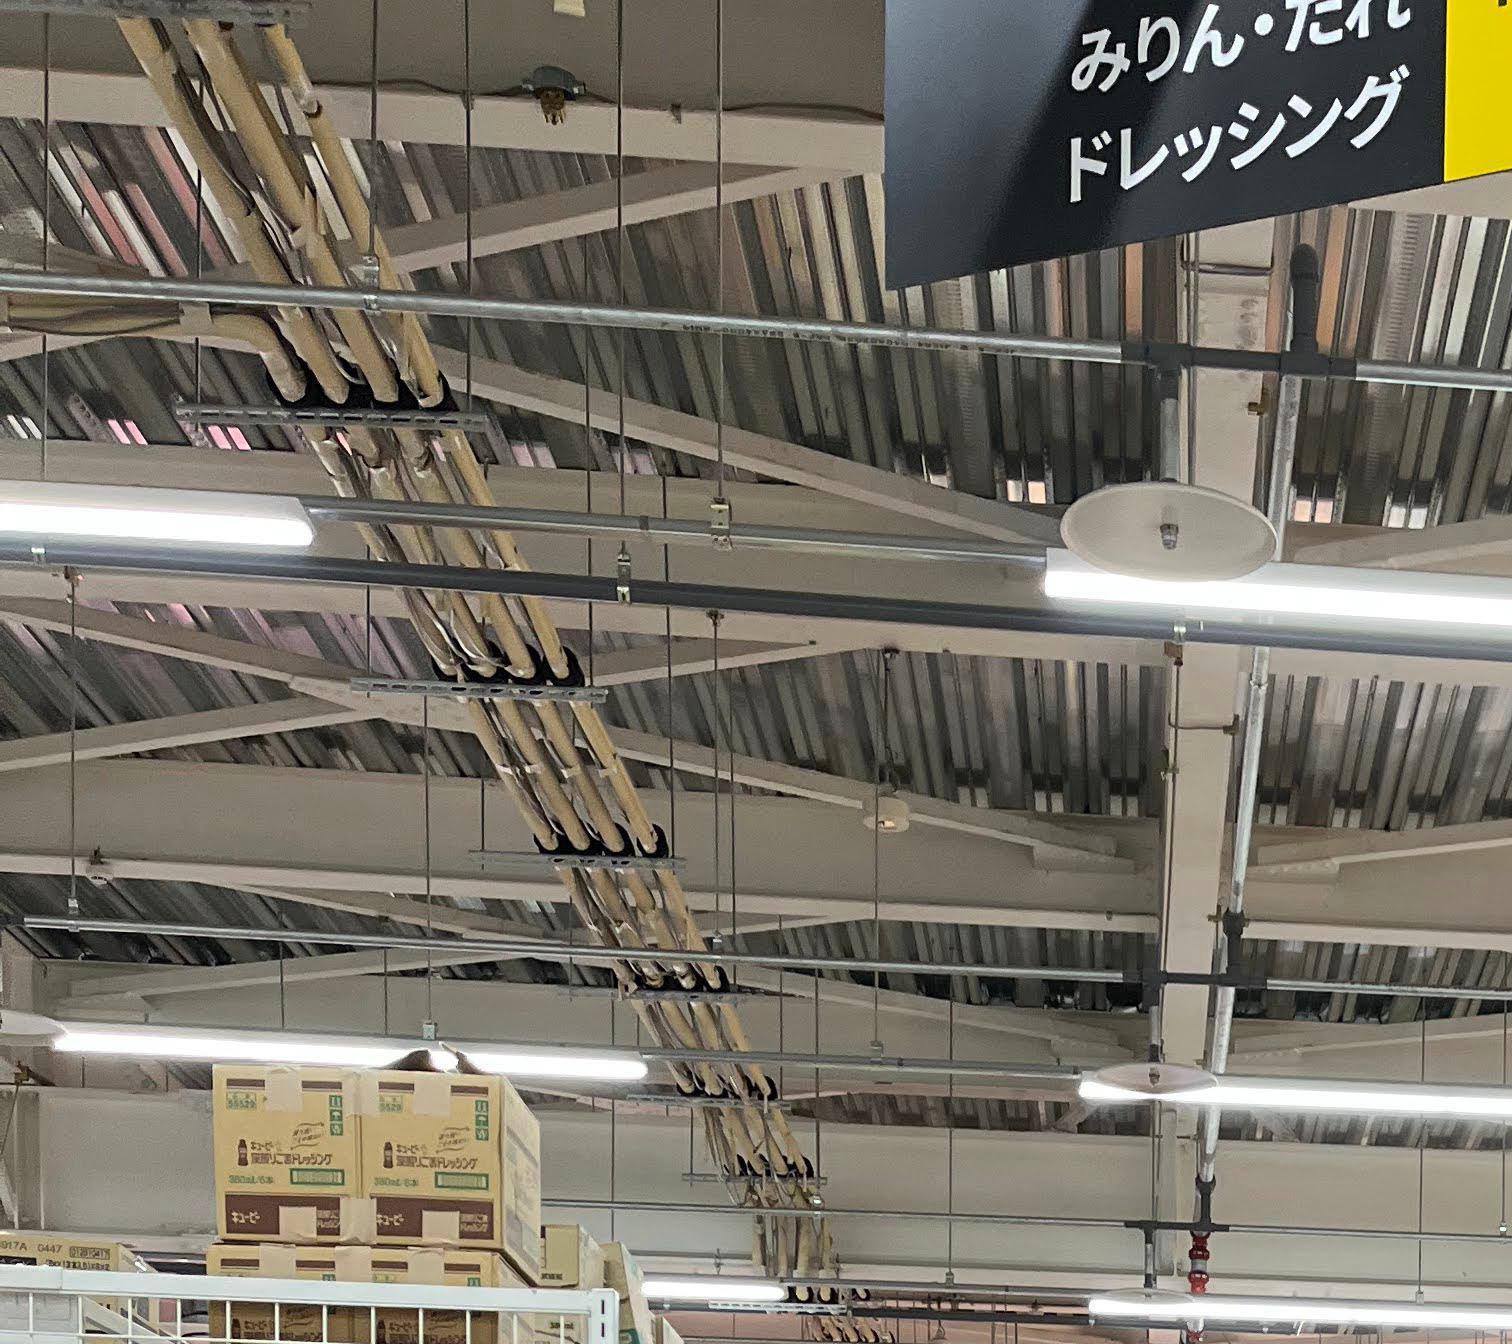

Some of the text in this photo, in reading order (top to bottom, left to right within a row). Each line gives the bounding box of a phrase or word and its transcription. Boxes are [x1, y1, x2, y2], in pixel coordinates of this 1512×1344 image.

[1070, 64, 1410, 203] ドレッシング
